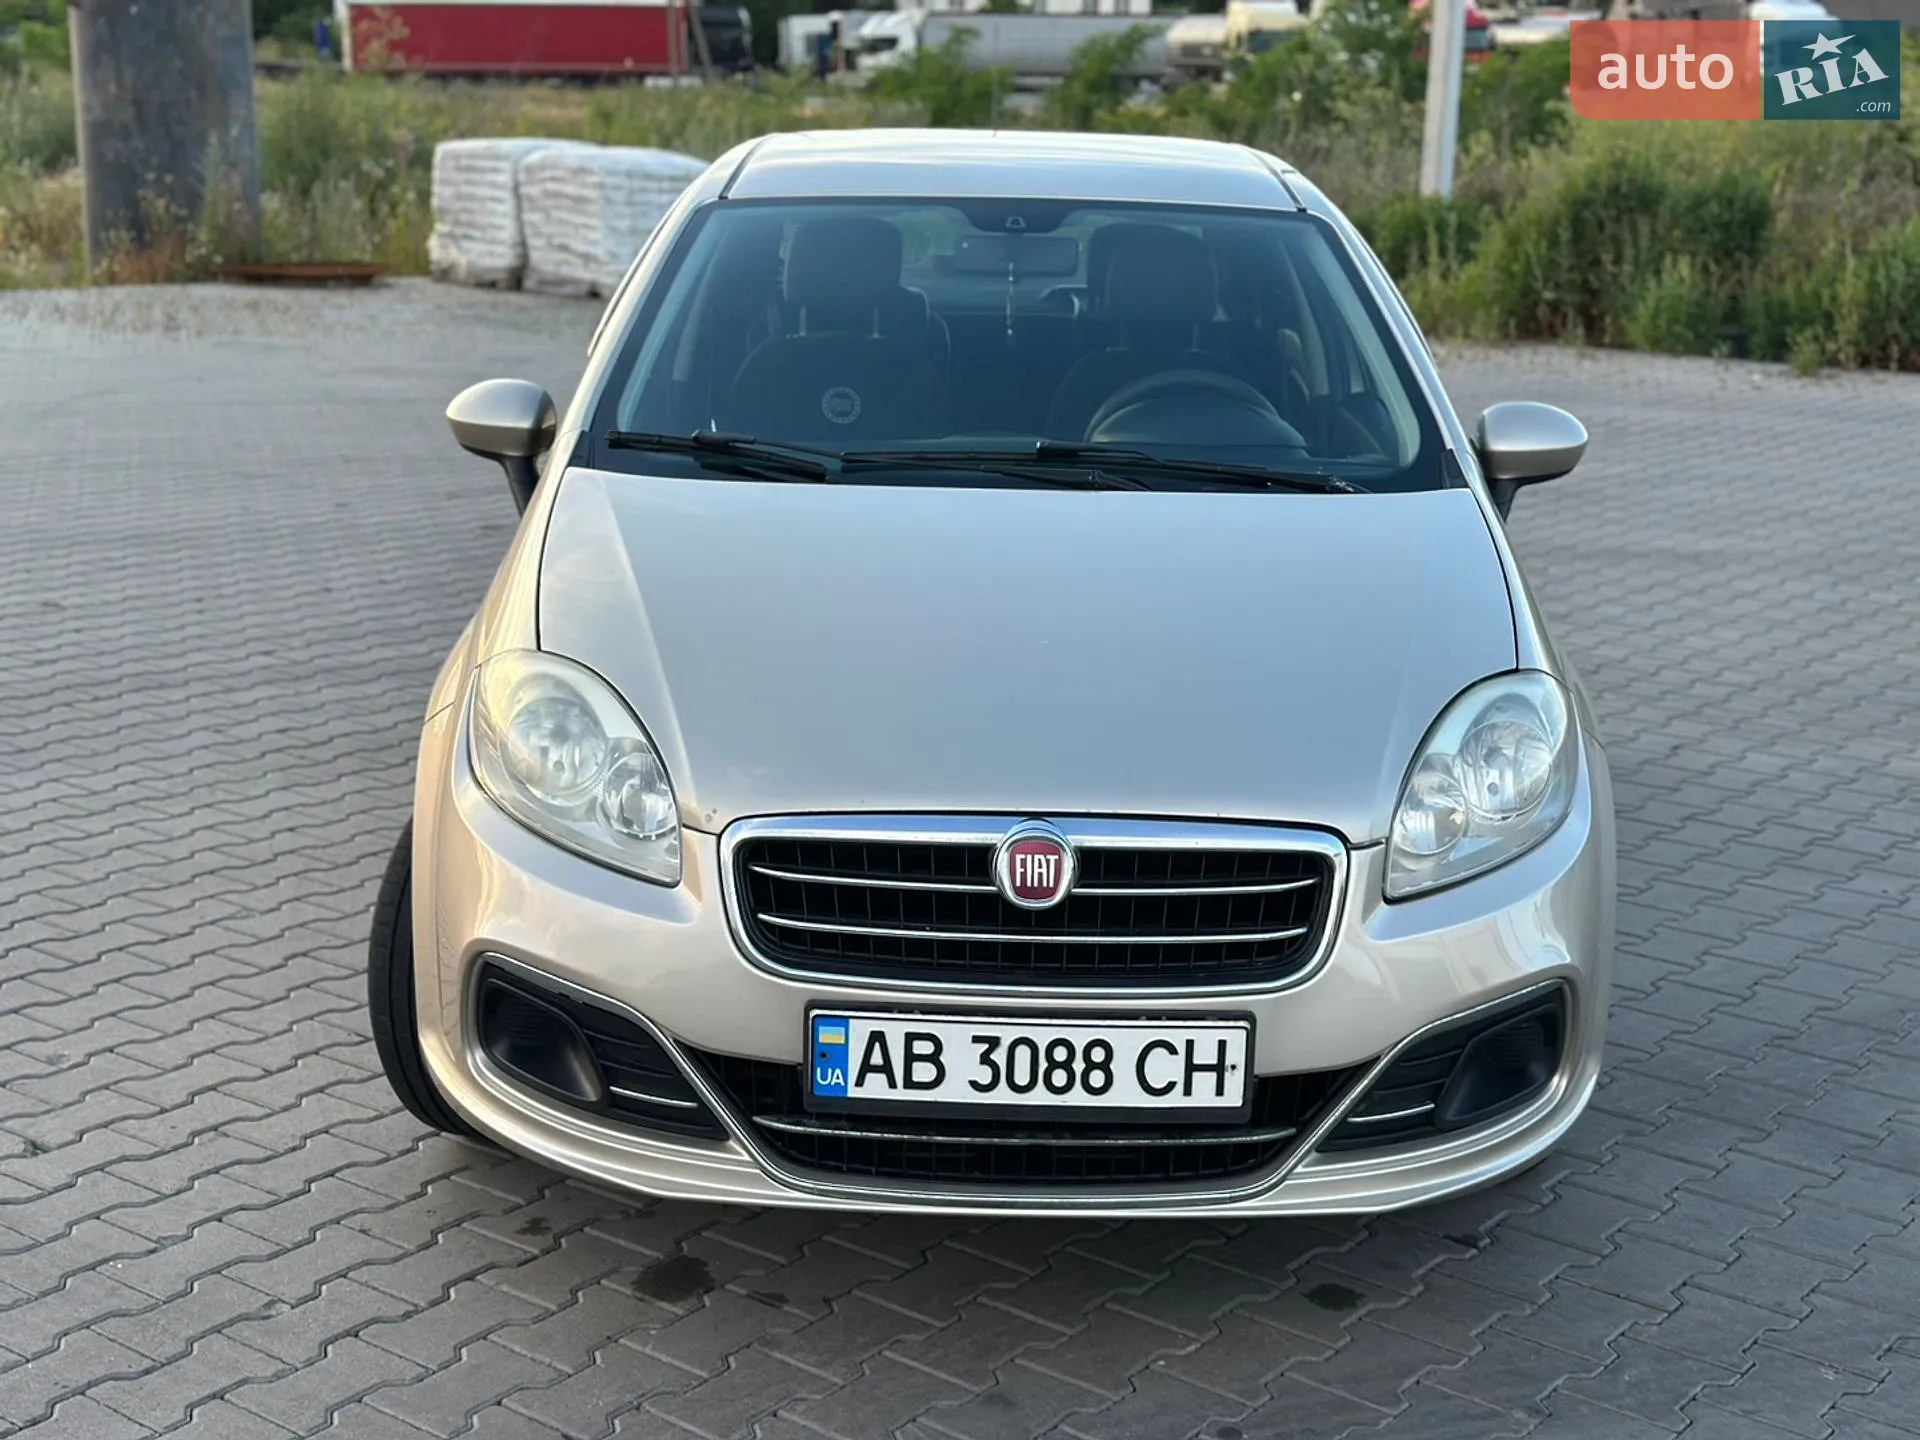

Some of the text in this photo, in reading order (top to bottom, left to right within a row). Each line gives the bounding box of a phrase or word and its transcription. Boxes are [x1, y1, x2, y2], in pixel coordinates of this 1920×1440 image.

[1015, 854, 1059, 888] FIAT
[816, 1068, 845, 1087] UA
[854, 1030, 1227, 1097] AB 3088 CH
